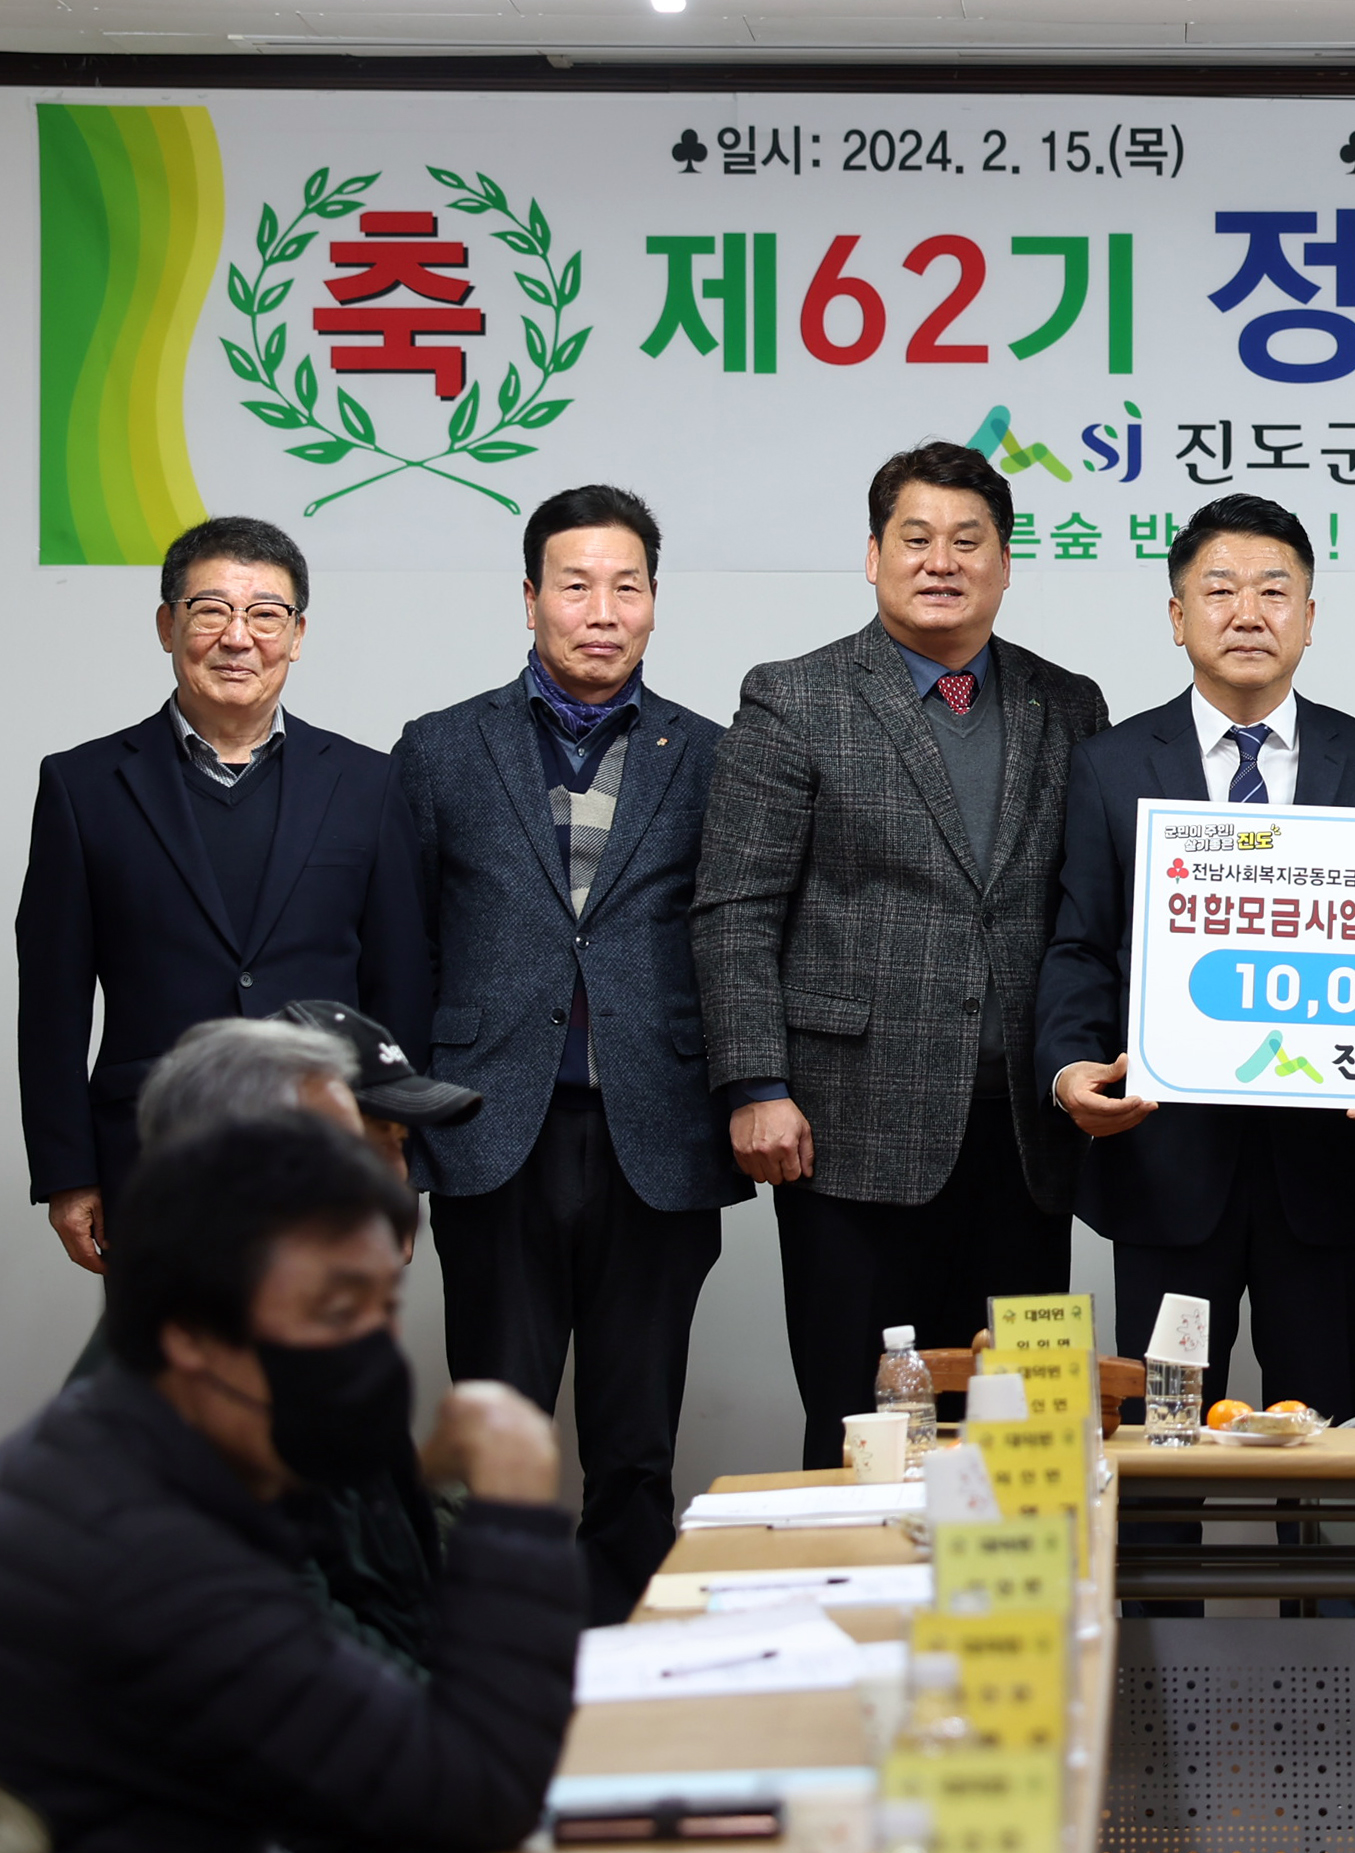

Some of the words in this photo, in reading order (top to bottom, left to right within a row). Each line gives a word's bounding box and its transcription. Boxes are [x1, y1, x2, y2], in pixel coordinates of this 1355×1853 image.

[716, 125, 823, 176] 일시:
[842, 129, 965, 174] 2024.
[982, 129, 1020, 174] 2.
[1041, 124, 1186, 178] 15.(목)
[312, 211, 486, 401] 축
[639, 231, 1134, 375] 제62기
[1010, 511, 1102, 560] 른숲
[1164, 824, 1202, 839] 군민이
[1236, 831, 1274, 850] 진도
